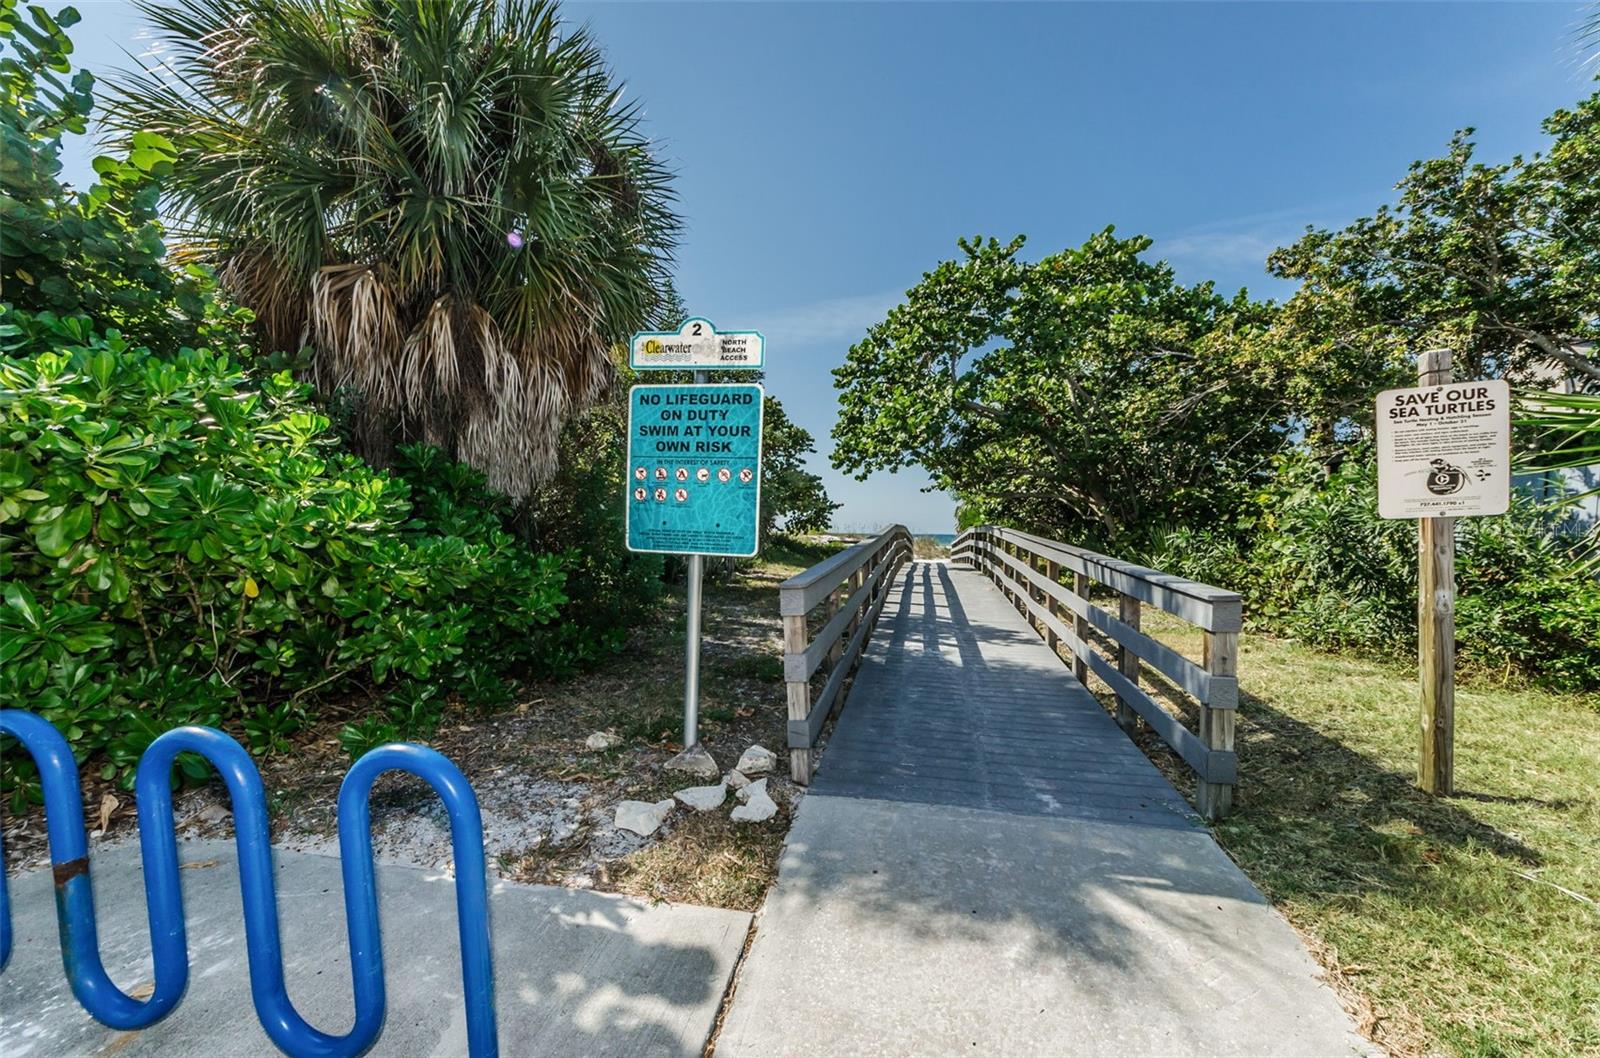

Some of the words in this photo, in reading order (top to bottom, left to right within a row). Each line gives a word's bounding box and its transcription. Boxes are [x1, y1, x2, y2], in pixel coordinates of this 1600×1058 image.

[692, 323, 702, 336] 2
[646, 340, 692, 354] Clearwater
[640, 394, 660, 405] NO
[666, 394, 753, 405] LIFEGUARD
[1395, 392, 1440, 407] SAVE
[1446, 387, 1488, 401] OUR
[1389, 406, 1420, 419] SEA
[1425, 399, 1496, 416] TURTLES
[660, 410, 682, 421] ON
[688, 410, 729, 421] DUTY
[639, 425, 679, 437] SWIM
[683, 426, 703, 437] AT
[708, 426, 751, 437] YOUR
[656, 441, 690, 452] OWN
[695, 441, 732, 452] RISK
